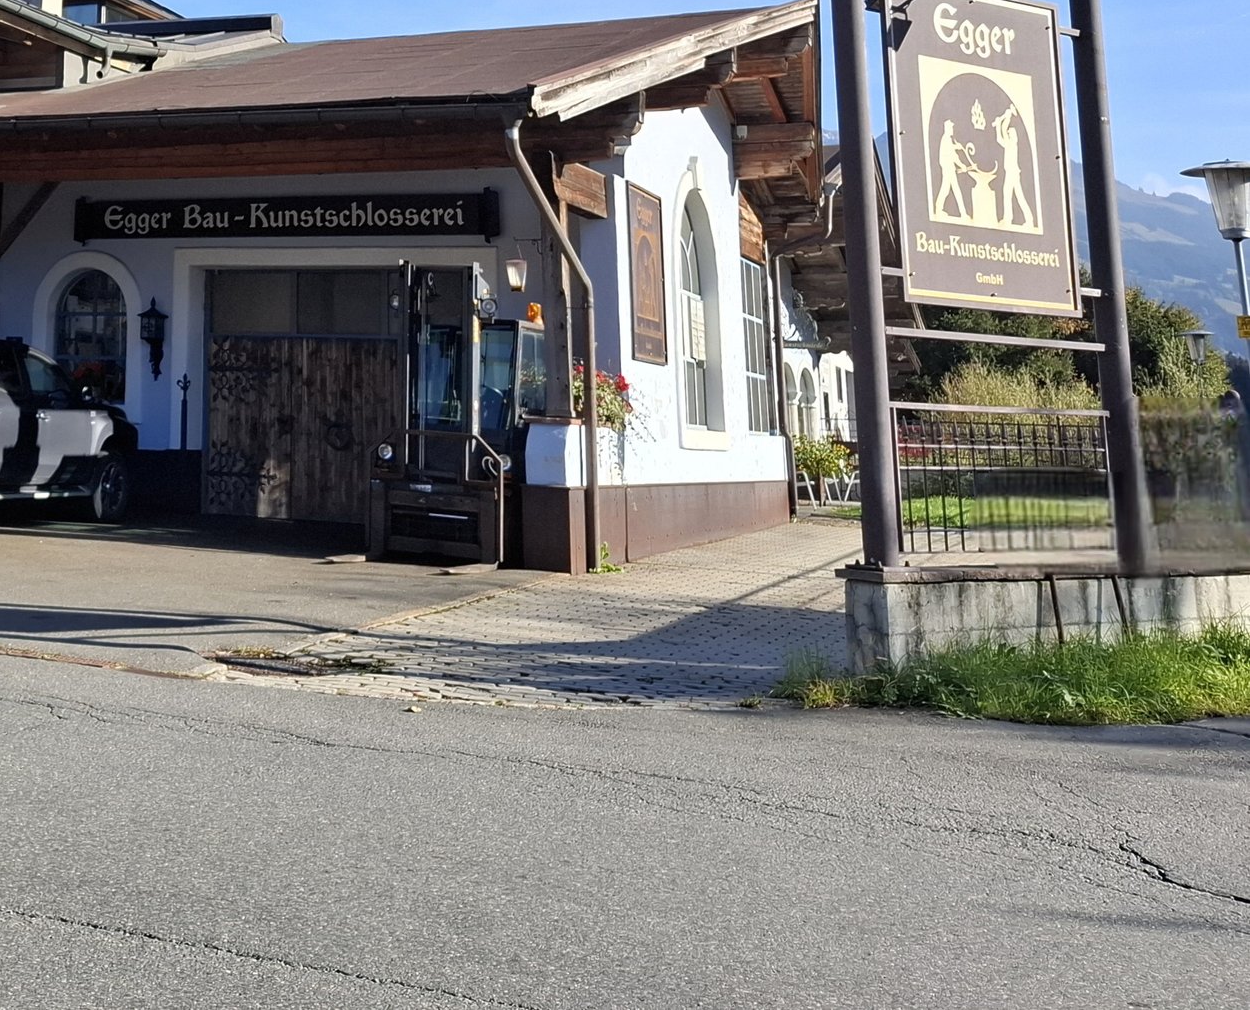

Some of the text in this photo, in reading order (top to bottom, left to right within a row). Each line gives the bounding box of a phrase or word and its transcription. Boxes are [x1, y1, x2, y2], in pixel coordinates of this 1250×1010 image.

[933, 2, 1016, 58] Egger
[104, 204, 171, 234] Egger
[915, 231, 1060, 268] Bau-Kunstschlosserei
[975, 271, 1004, 286] GmbH
